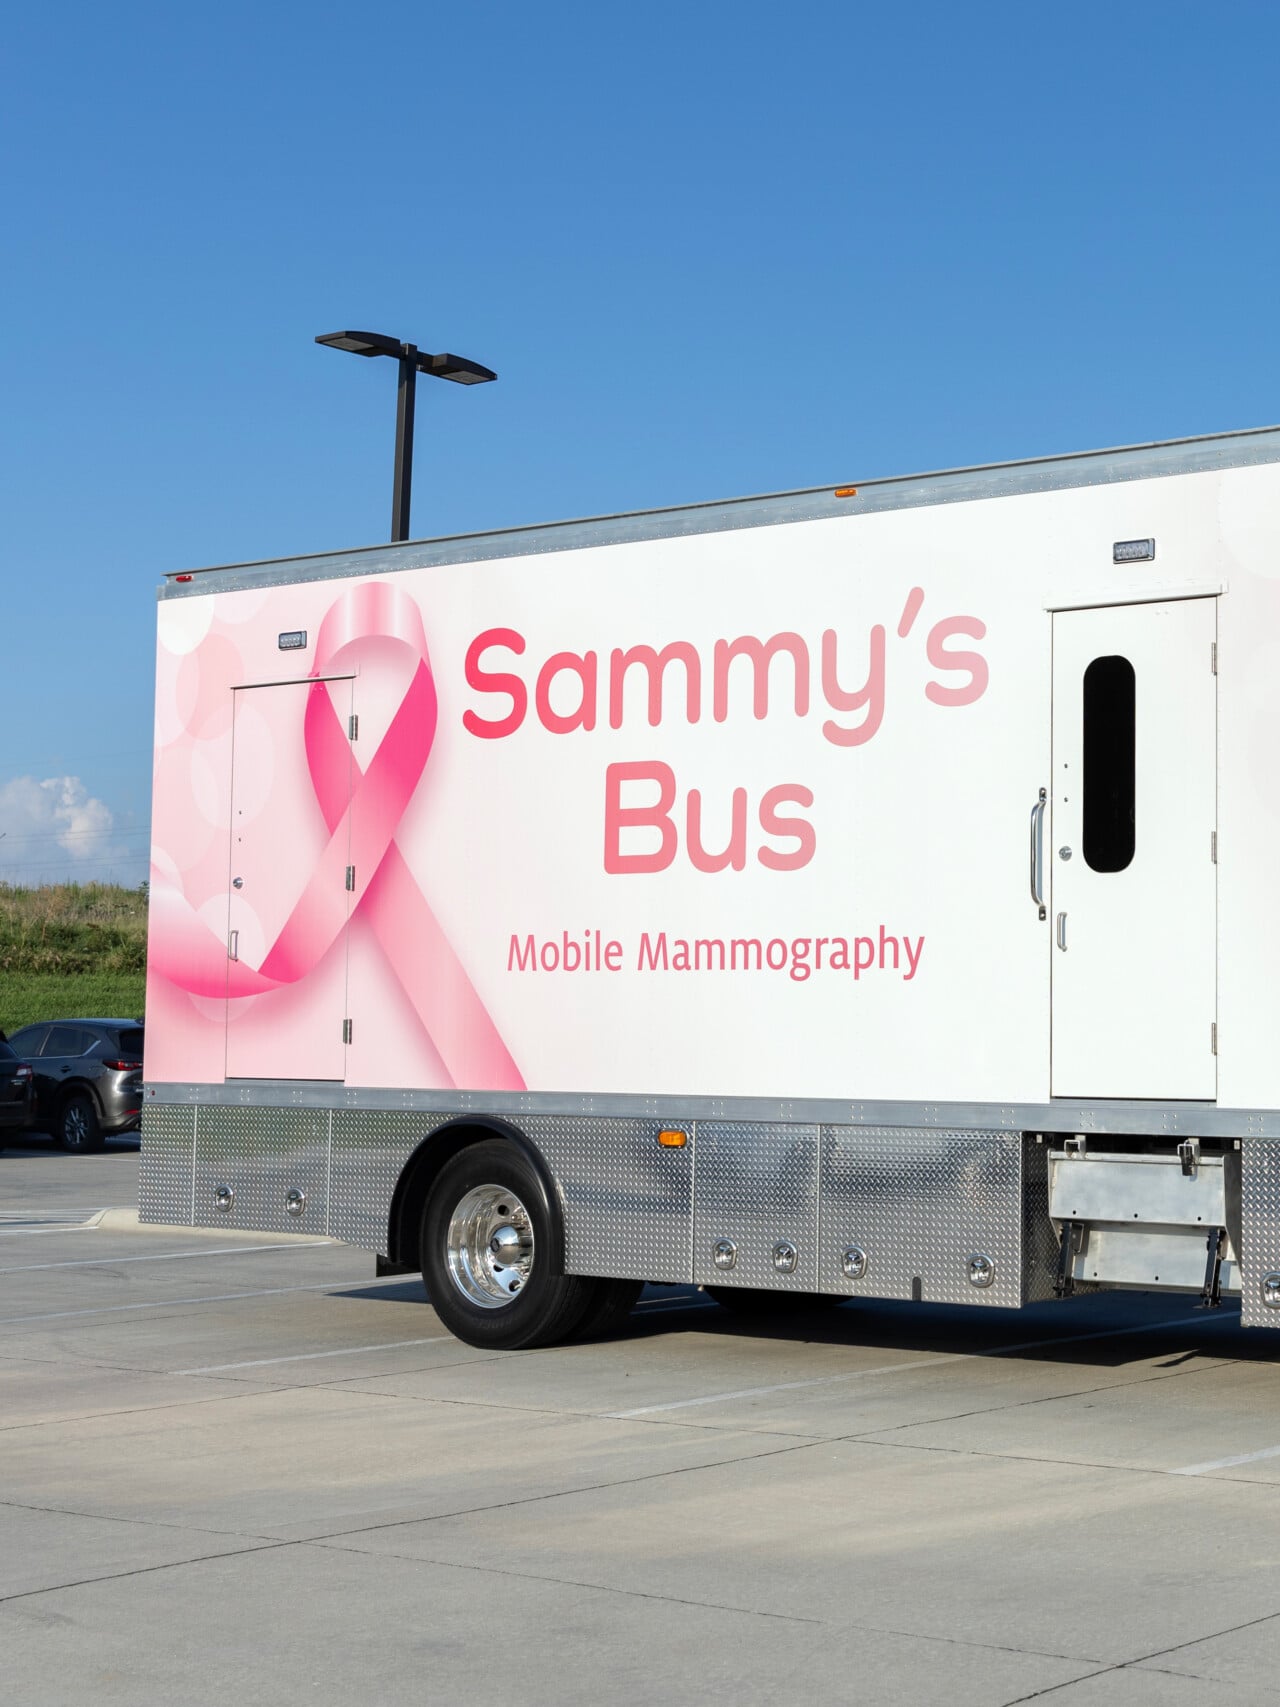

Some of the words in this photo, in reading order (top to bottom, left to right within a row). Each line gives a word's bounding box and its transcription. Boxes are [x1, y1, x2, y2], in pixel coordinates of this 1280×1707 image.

[461, 586, 990, 748] Sammy's
[603, 759, 818, 875] Bus
[507, 928, 624, 973] Mobile
[637, 924, 926, 982] Mammography
